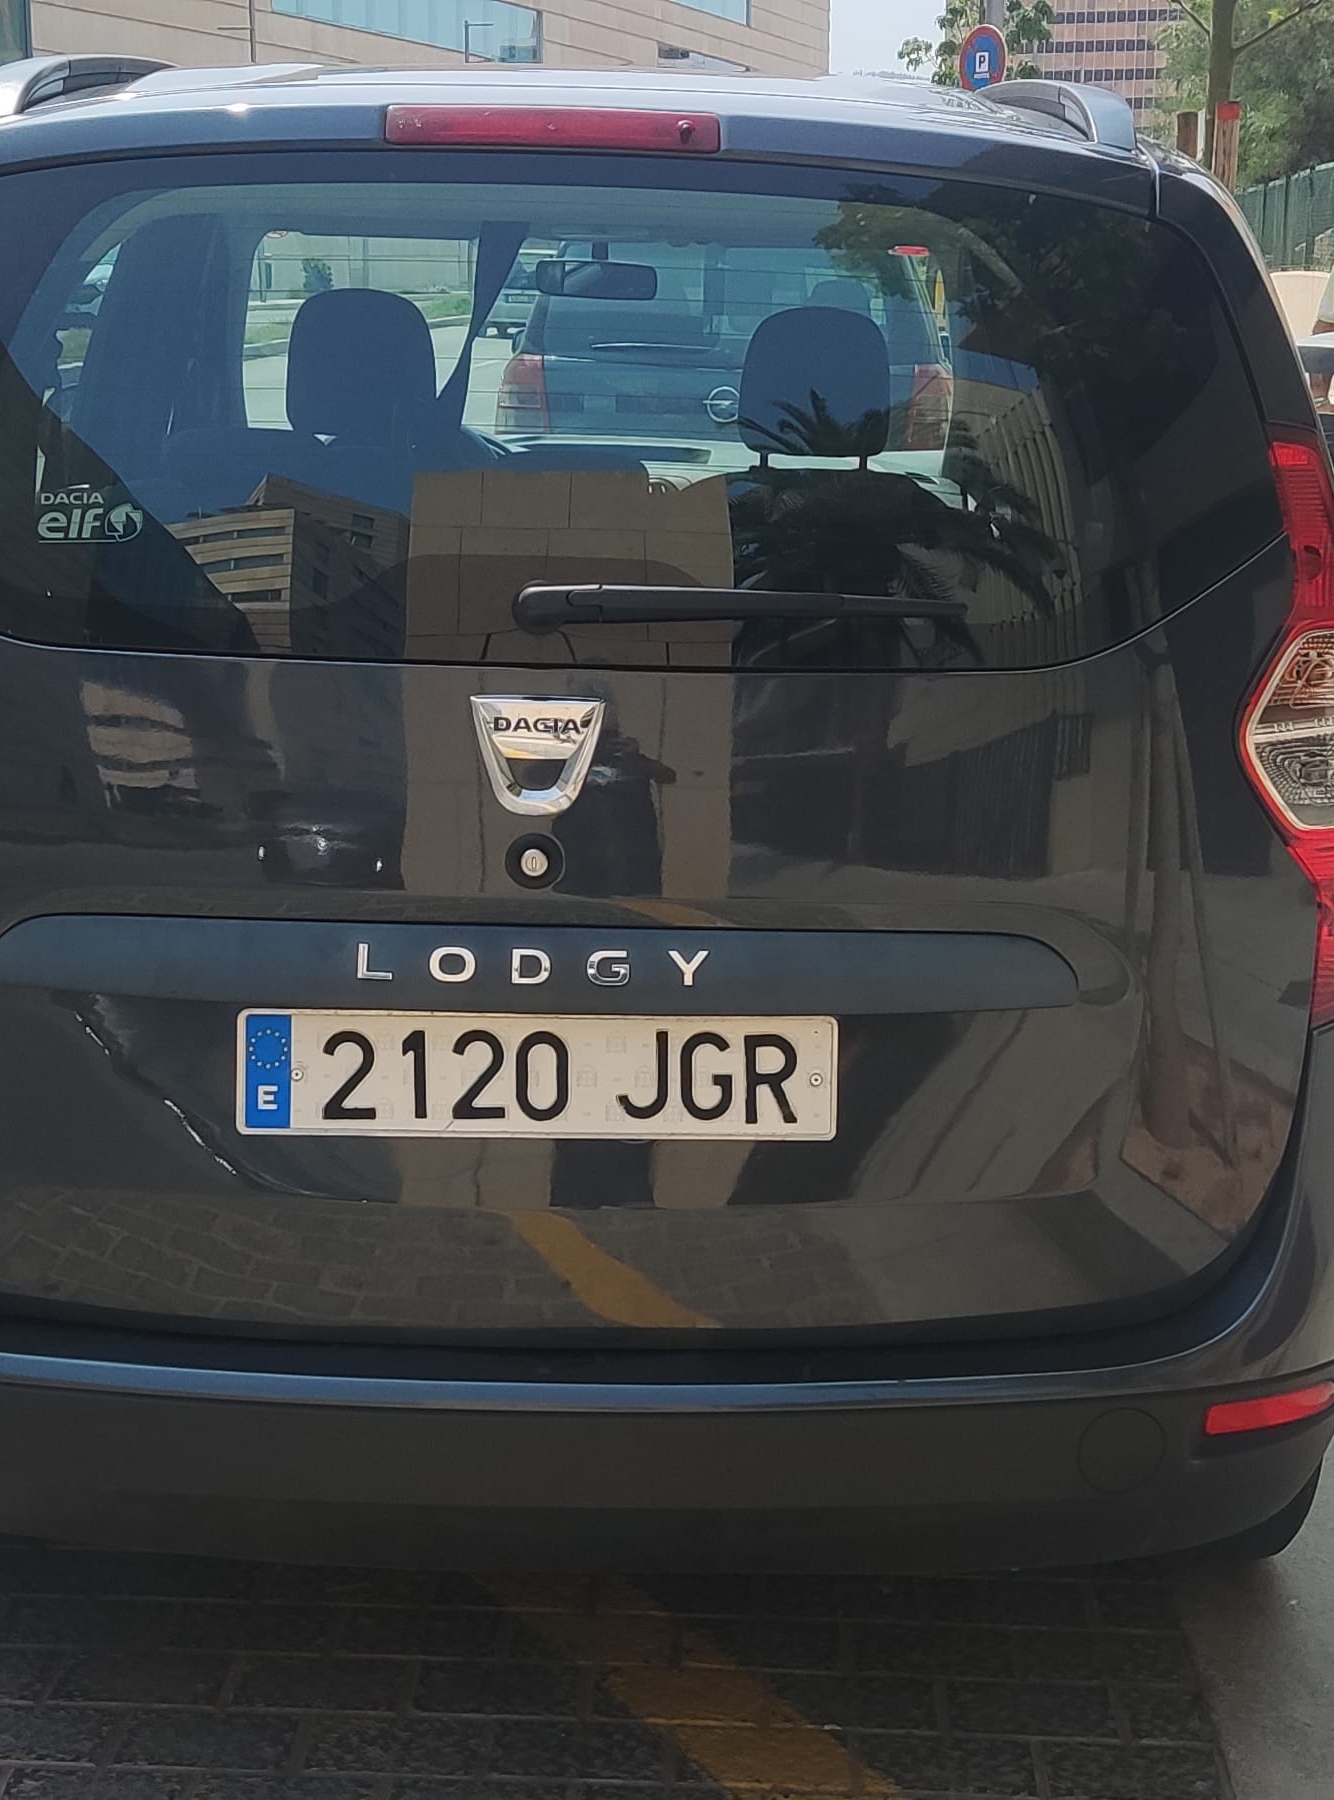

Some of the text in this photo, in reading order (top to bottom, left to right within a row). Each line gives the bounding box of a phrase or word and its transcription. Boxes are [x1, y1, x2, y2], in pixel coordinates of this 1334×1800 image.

[978, 54, 986, 70] P
[40, 492, 105, 505] DACIA
[36, 507, 105, 539] elf
[493, 716, 581, 734] DACIA
[355, 943, 710, 986] LODGY
[321, 1029, 799, 1125] 2120 JGR
[256, 1085, 279, 1110] E
